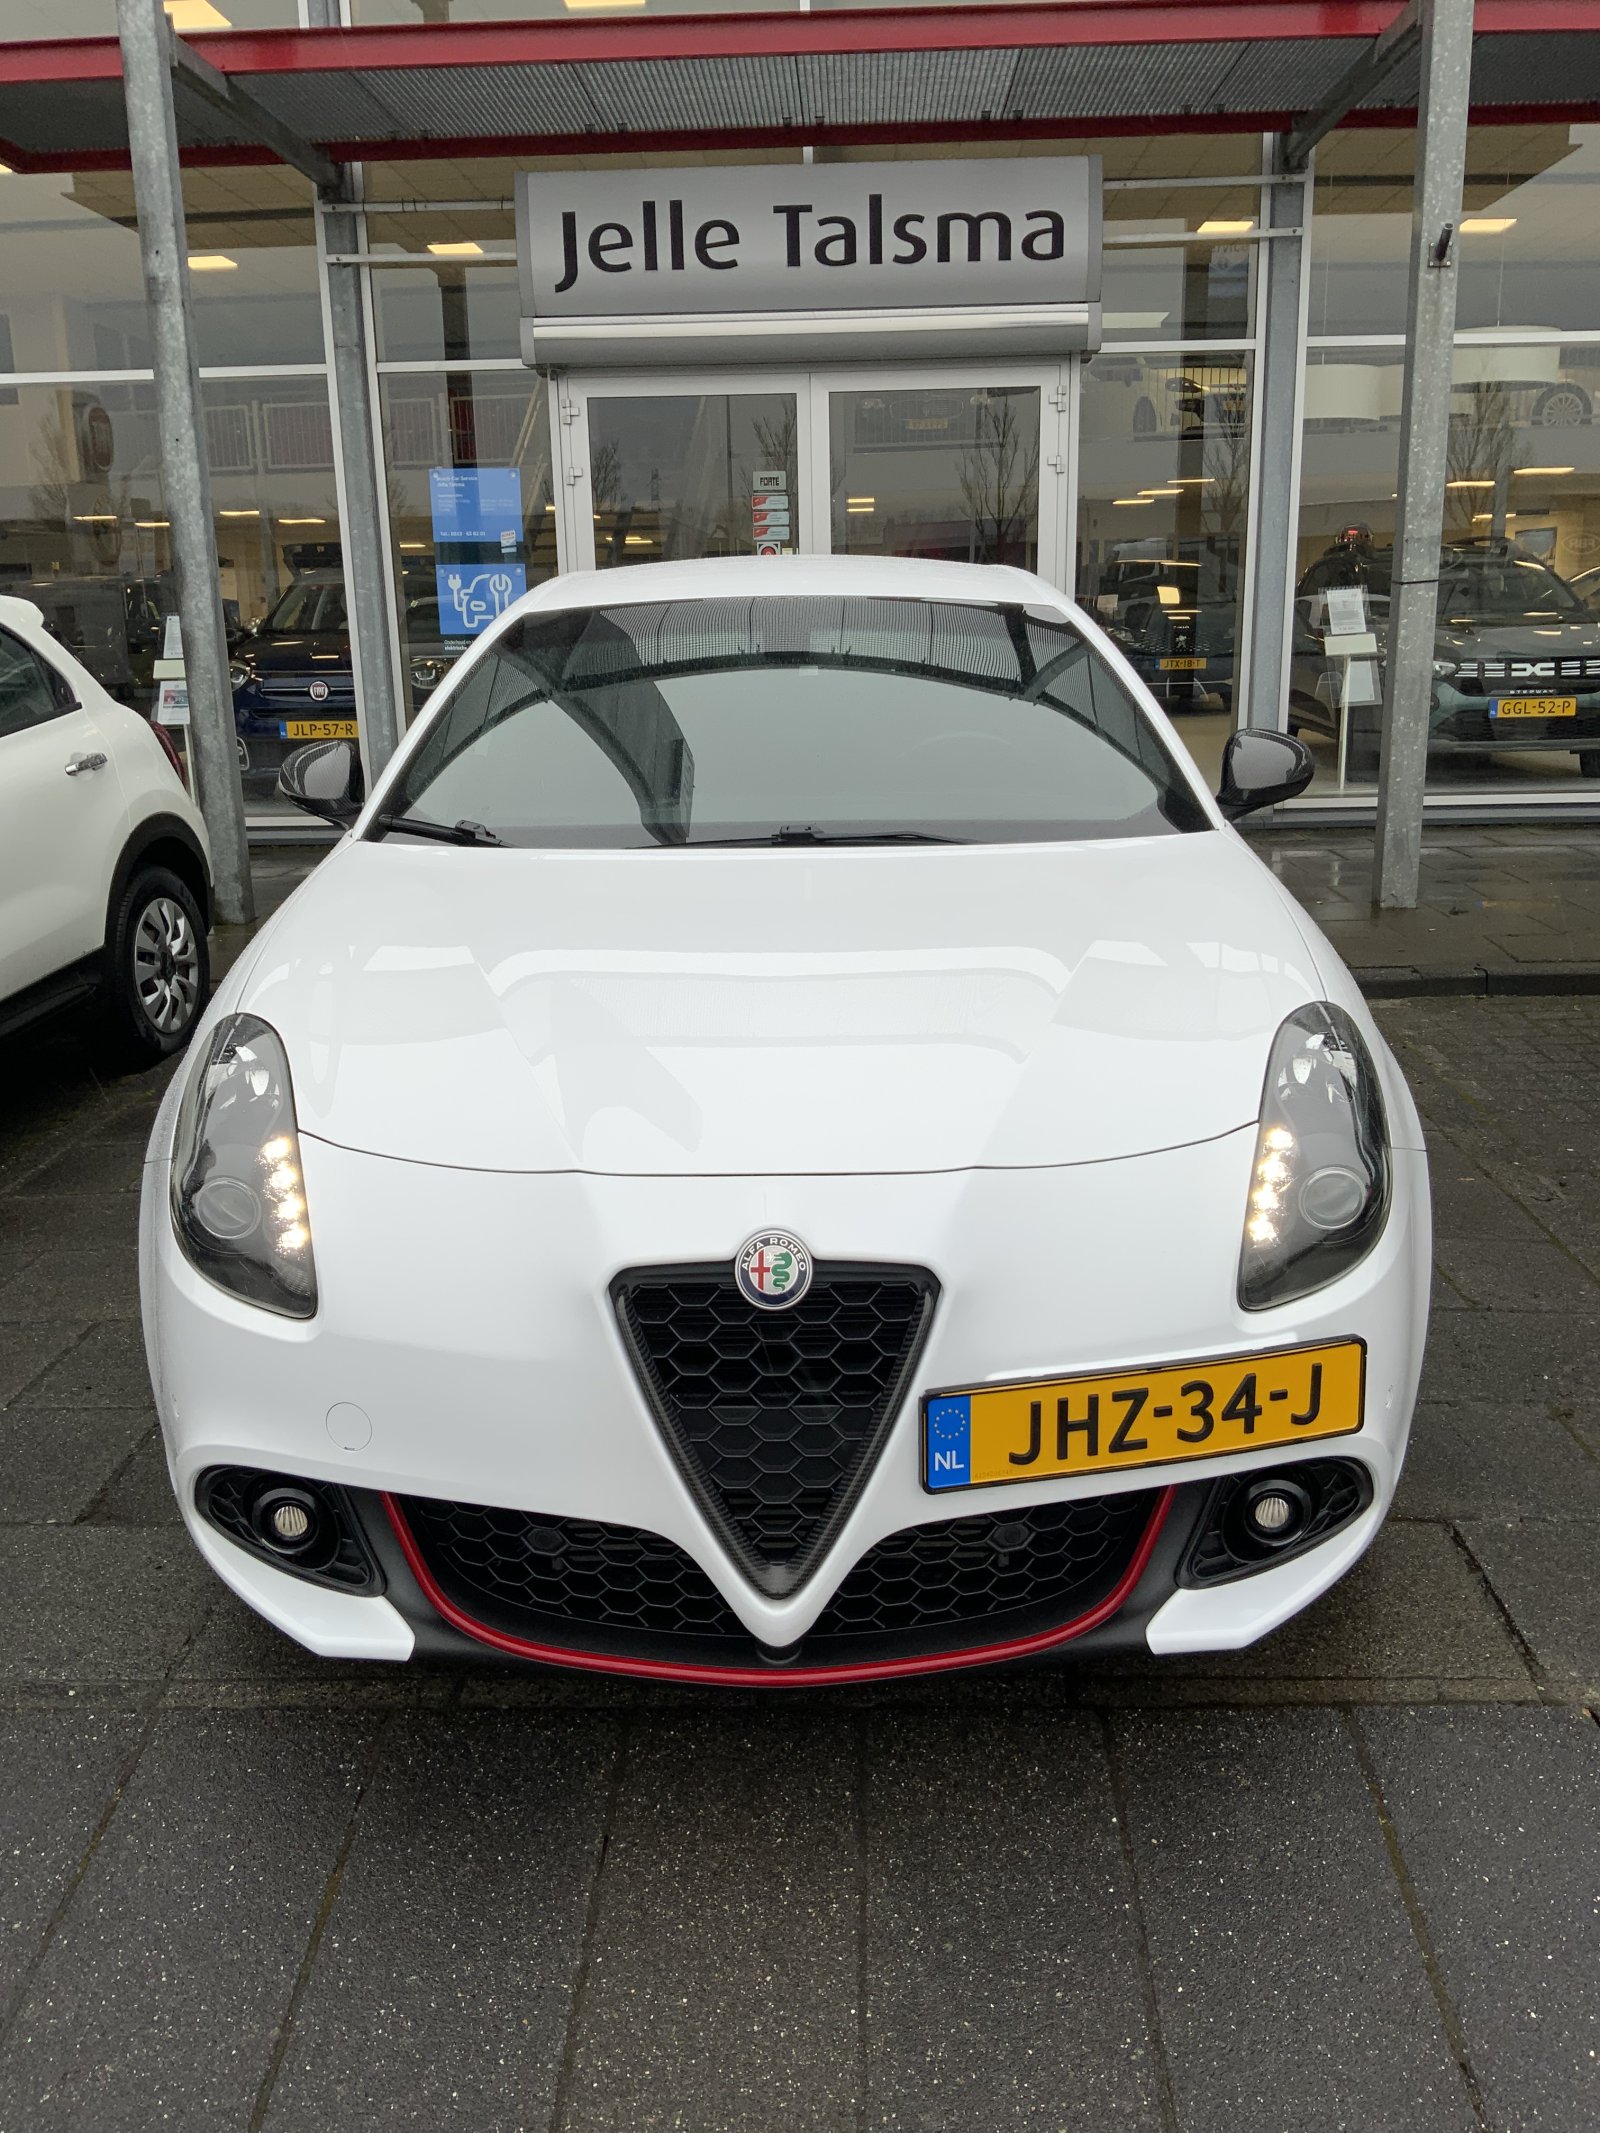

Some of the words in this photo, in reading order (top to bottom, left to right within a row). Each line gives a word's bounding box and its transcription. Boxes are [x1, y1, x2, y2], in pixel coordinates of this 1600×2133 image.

[554, 199, 740, 293] Jelle
[773, 193, 1065, 268] Talsma
[313, 686, 325, 696] FIAT
[1502, 700, 1571, 715] GGL-52-P
[293, 723, 354, 736] JLP-57-R
[741, 1241, 765, 1271] ALFA
[769, 1237, 807, 1271] ROMEO
[934, 1450, 965, 1472] NL
[1008, 1361, 1323, 1466] JHZ-34-J
